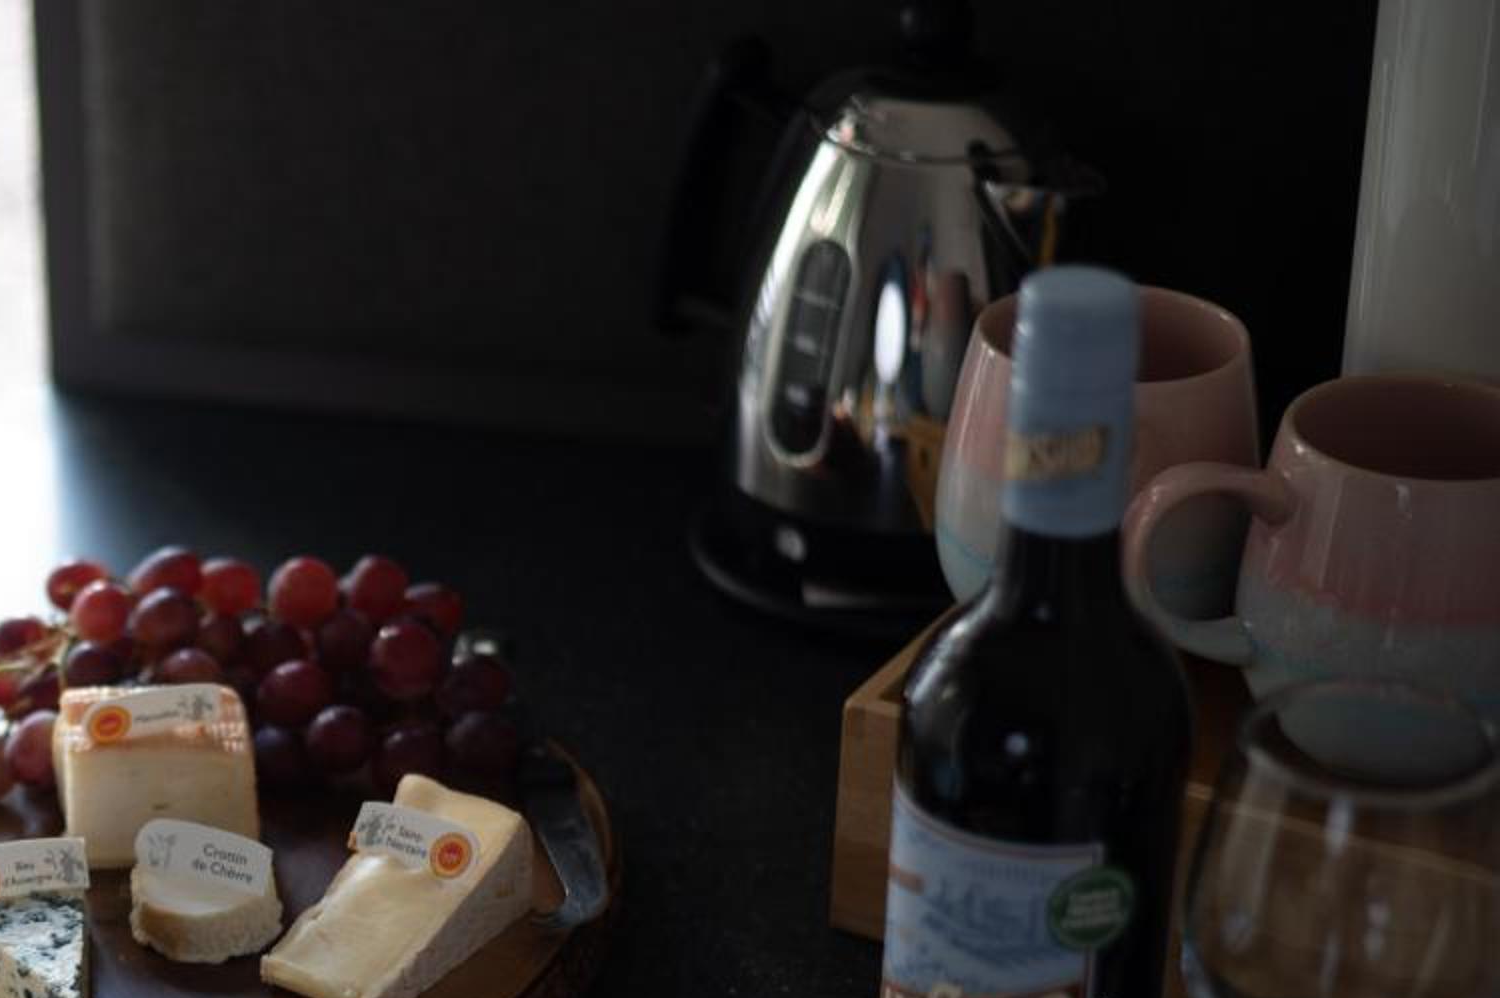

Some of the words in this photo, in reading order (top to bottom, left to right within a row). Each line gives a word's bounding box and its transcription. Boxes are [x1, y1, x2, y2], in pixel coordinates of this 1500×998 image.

[203, 842, 248, 866] Crottin
[191, 859, 206, 872] de
[209, 861, 254, 884] Chèvre
